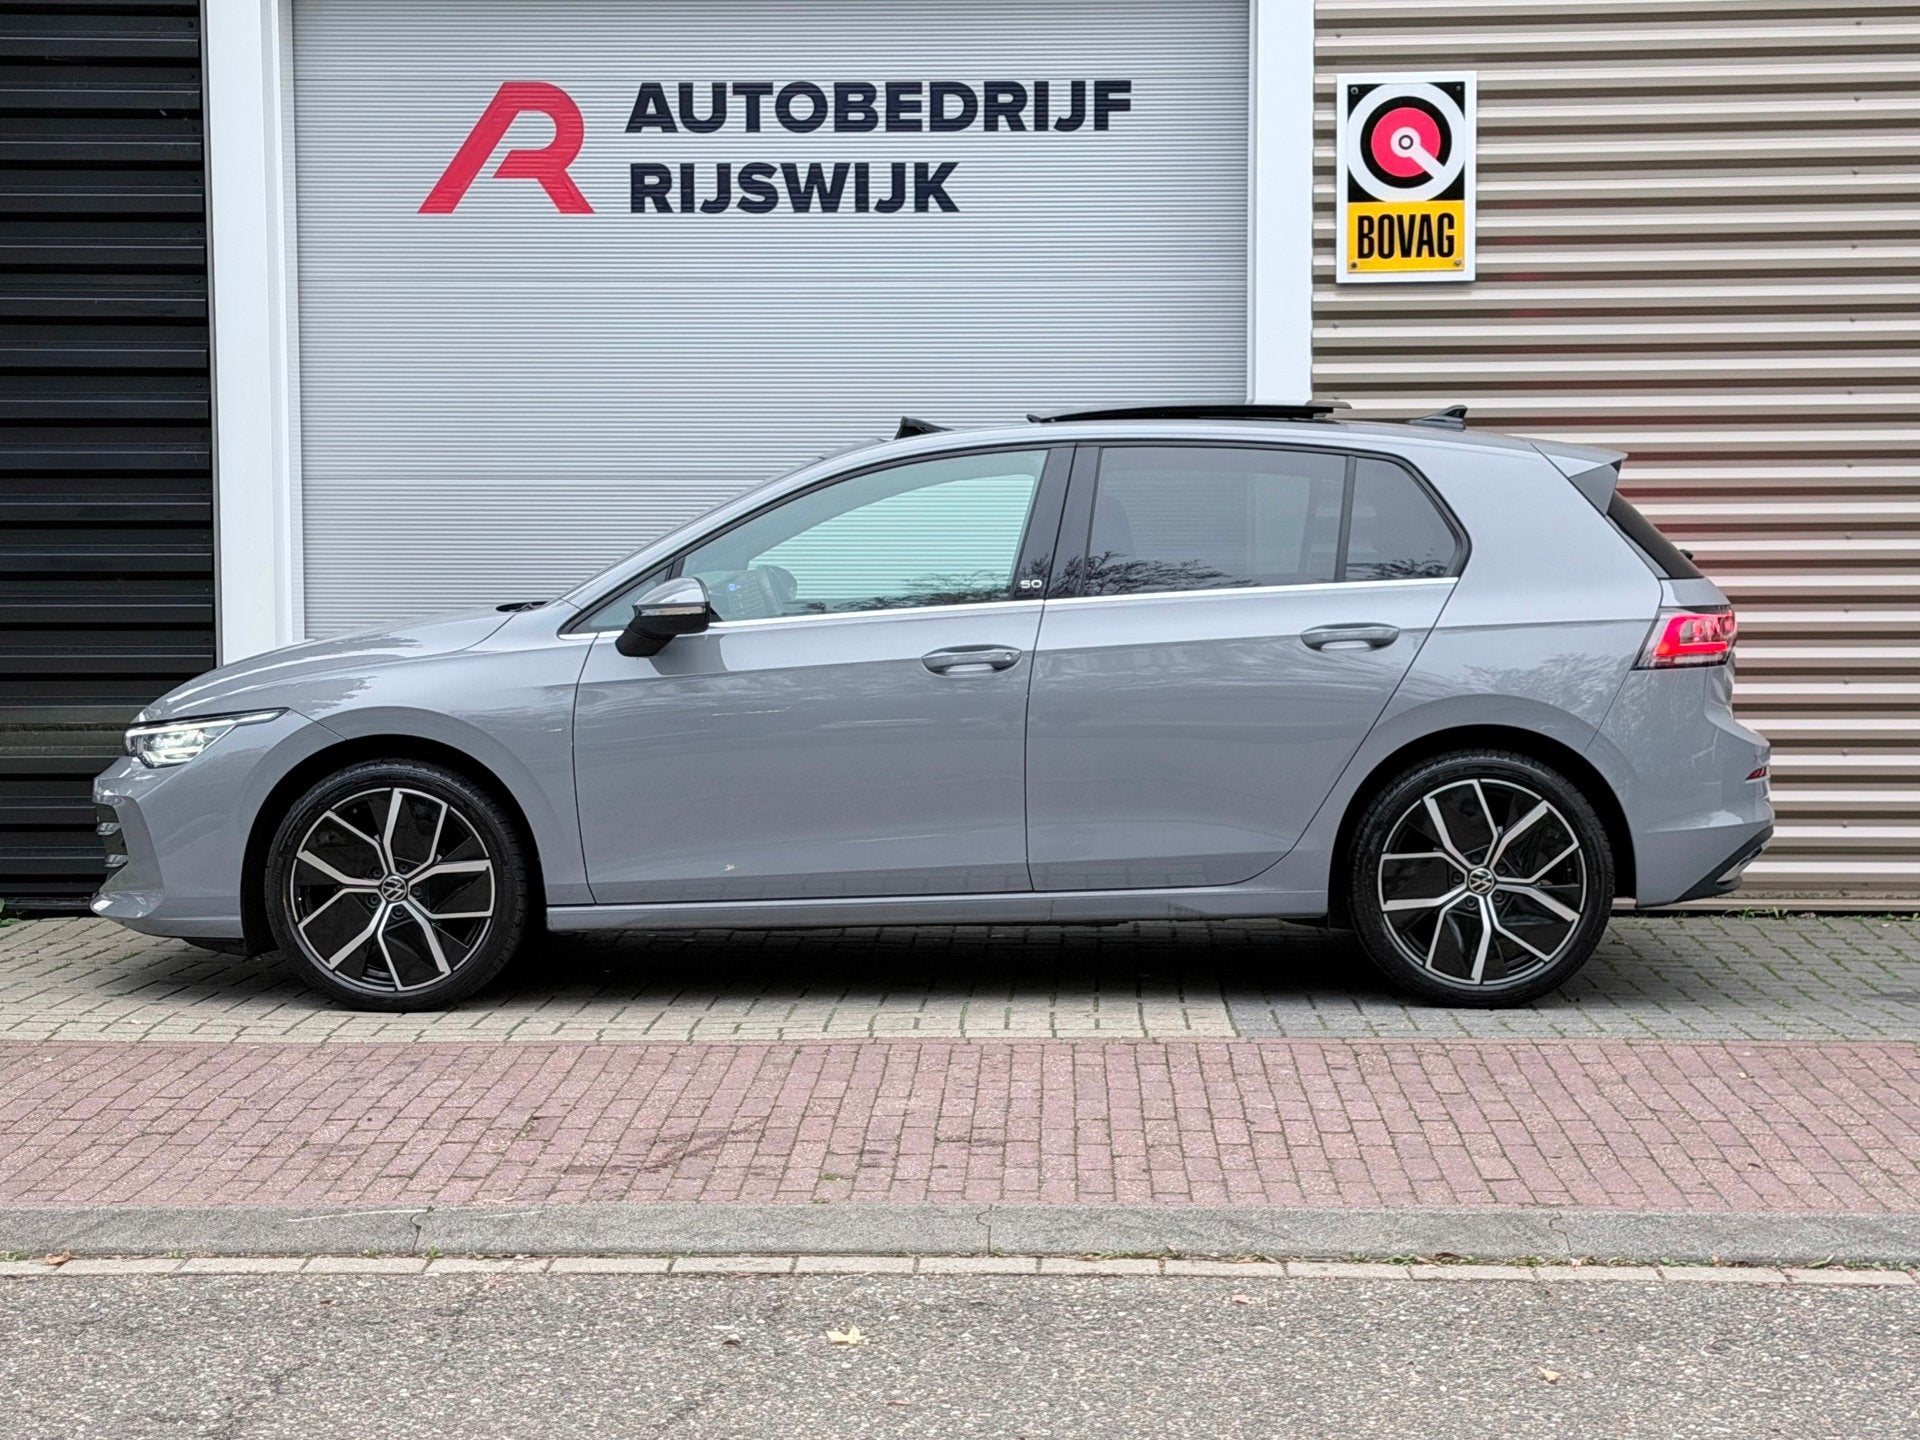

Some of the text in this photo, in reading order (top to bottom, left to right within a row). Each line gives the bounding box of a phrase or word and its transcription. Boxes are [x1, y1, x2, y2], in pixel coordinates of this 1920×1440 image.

[625, 80, 1132, 133] AUTOBEDRIJF
[629, 162, 961, 214] RIJSWIJK
[1357, 212, 1455, 259] BOVAG
[1020, 579, 1043, 589] 50
